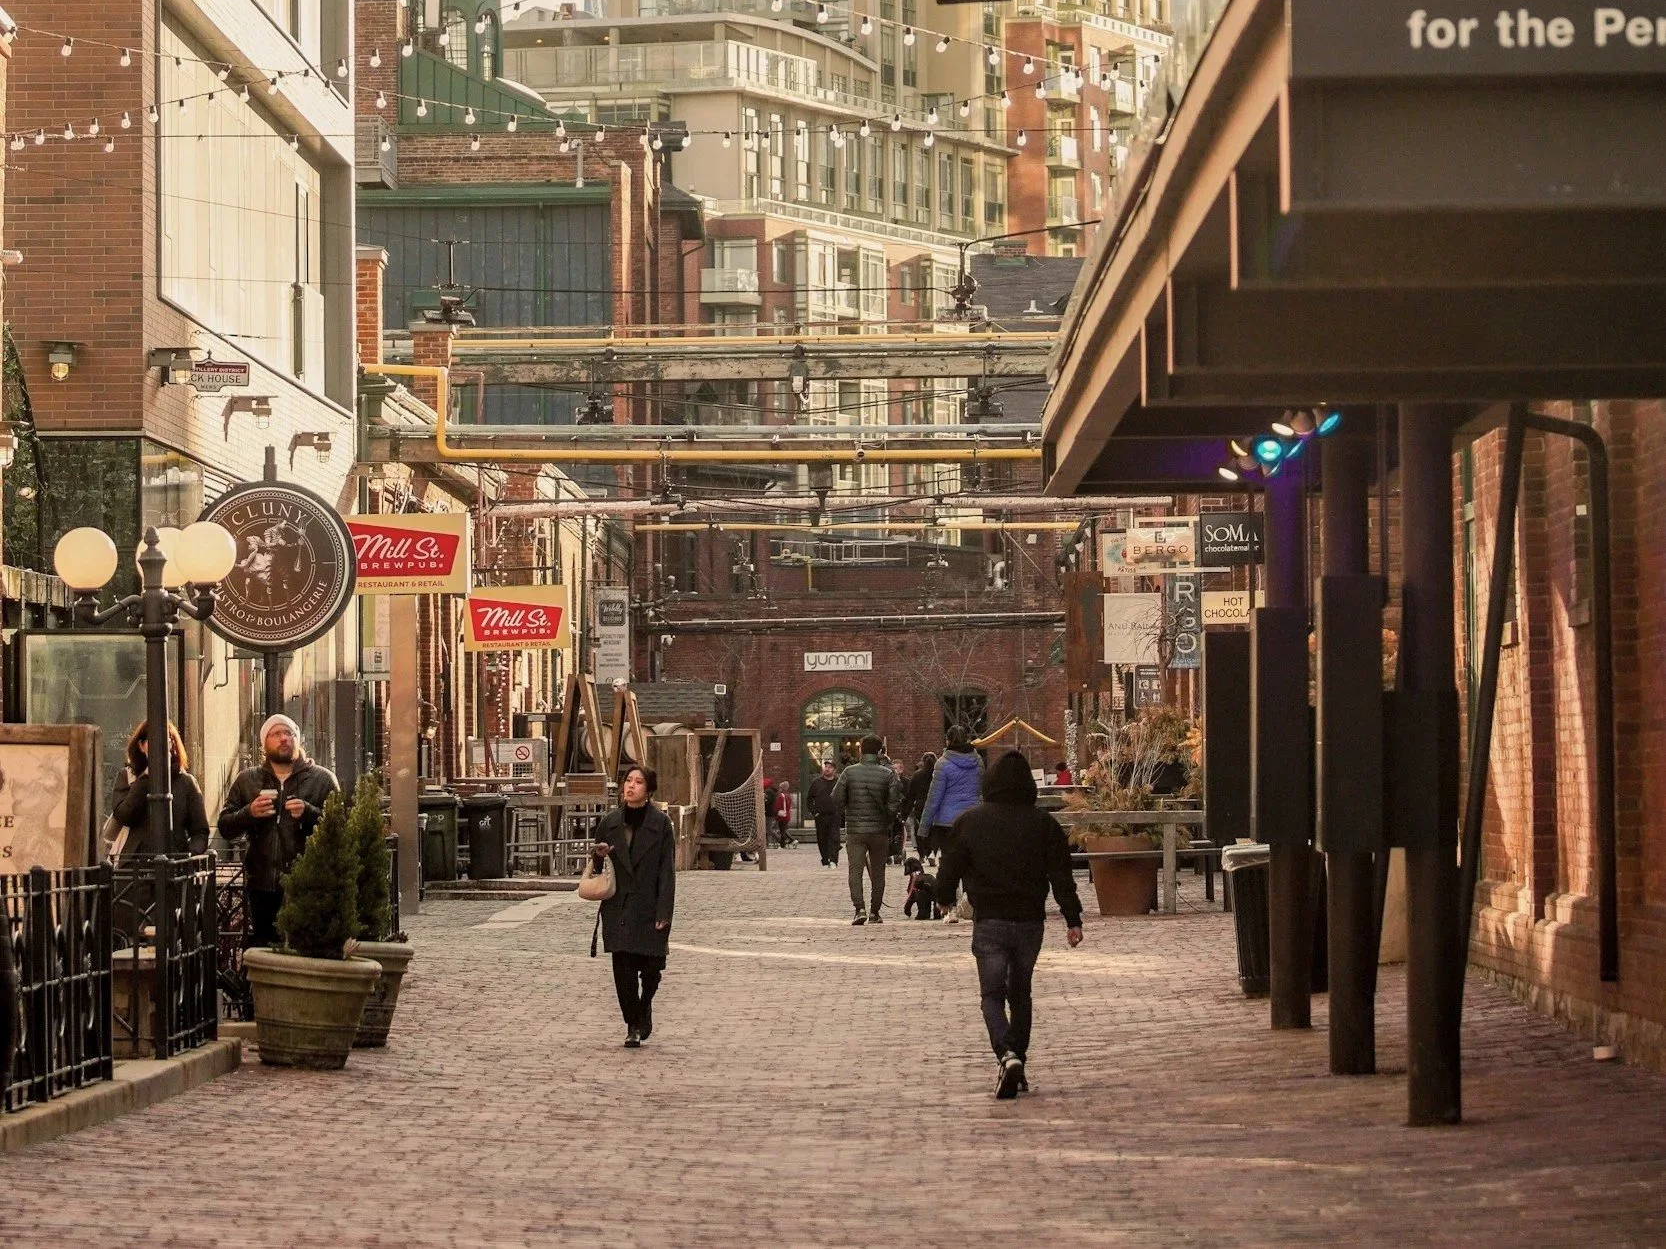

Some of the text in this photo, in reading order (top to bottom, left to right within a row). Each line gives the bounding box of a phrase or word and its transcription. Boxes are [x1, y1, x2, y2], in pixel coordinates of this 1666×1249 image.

[1407, 9, 1479, 48] for
[1495, 8, 1575, 48] the
[188, 374, 241, 383] CK HOUSE
[232, 502, 308, 525] CLUNY
[353, 534, 444, 559] Mill St.
[1133, 545, 1188, 554] BERGO
[1205, 543, 1259, 552] chocolatemar
[246, 614, 255, 622] &
[257, 580, 328, 626] BOULANGERIE
[1223, 597, 1243, 606] HOT
[477, 607, 551, 627] Mill St.
[806, 654, 868, 669] yummi
